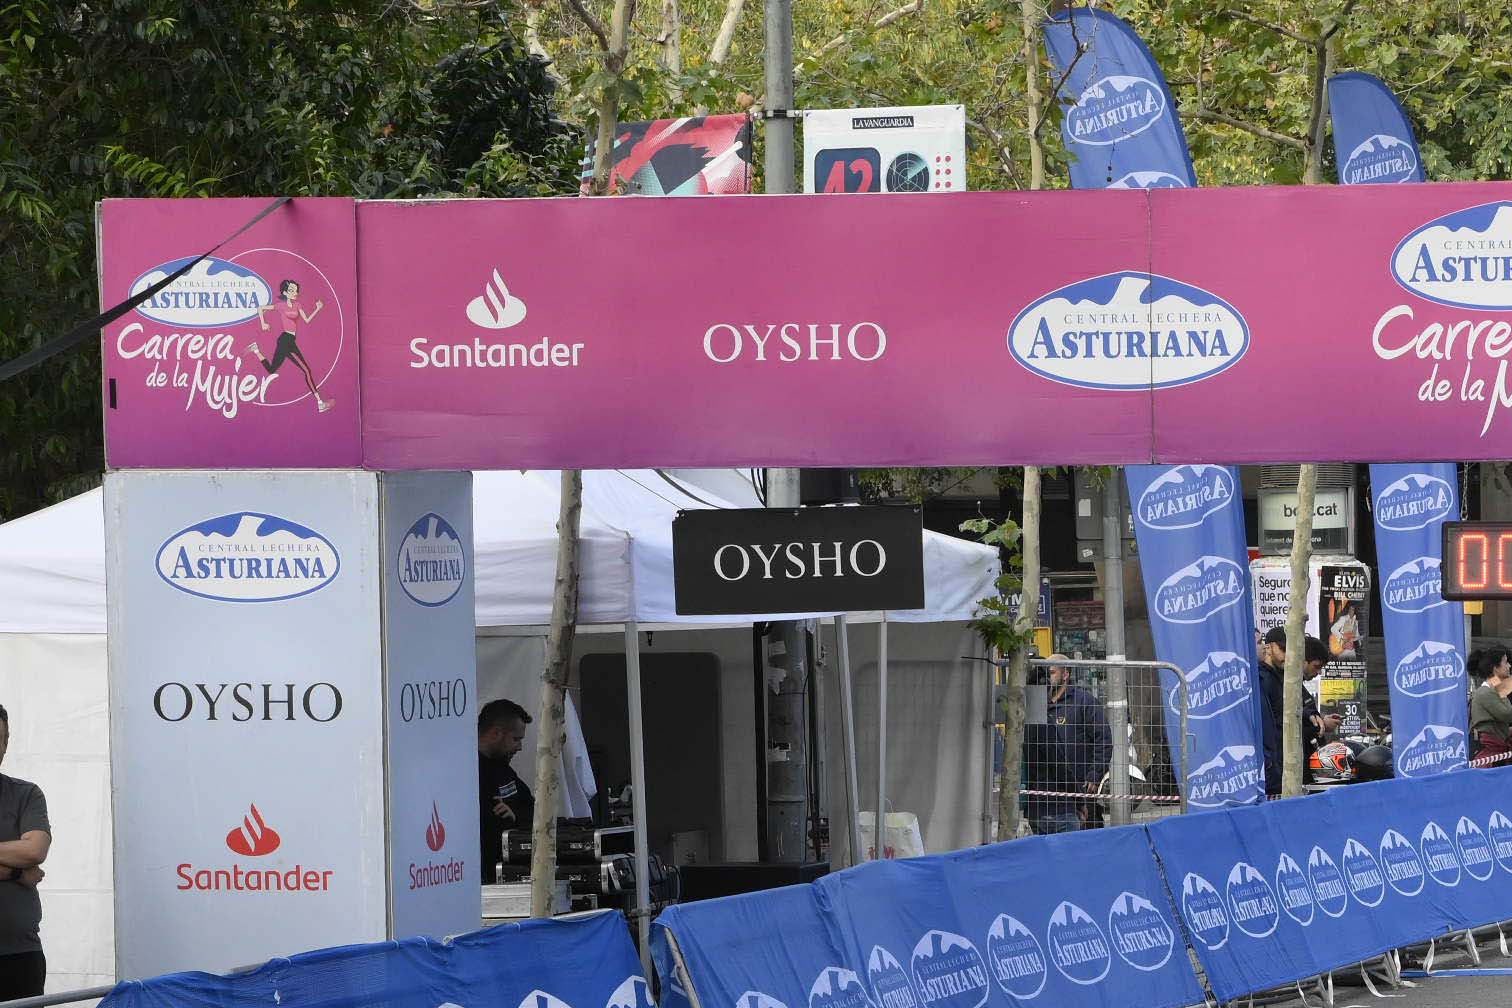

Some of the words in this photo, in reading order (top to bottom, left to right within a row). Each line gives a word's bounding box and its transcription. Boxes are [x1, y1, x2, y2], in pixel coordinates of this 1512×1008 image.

[854, 119, 864, 128] LA
[864, 117, 914, 128] VANGUARDIA
[162, 280, 206, 288] ENTRAL
[211, 279, 257, 288] LECHERA
[1064, 313, 1138, 325] CENTRAL
[1146, 312, 1222, 323] LECHERA
[117, 323, 234, 360] Carrera
[410, 337, 584, 368] Santander
[703, 321, 887, 363] OYSHO
[1027, 316, 1231, 359] ASTURIANA
[146, 362, 168, 387] de
[173, 363, 189, 388] la
[186, 357, 279, 419] Mujer
[1418, 363, 1453, 402] de
[1460, 363, 1485, 402] la
[171, 546, 327, 579] ASTURIANA
[199, 544, 256, 552] CENTRAL
[262, 544, 320, 552] LECHERA
[714, 539, 886, 581] OYSHO
[403, 548, 461, 582] ASTURIANA
[1334, 575, 1364, 587] ELVIS
[1260, 593, 1277, 603] que
[1261, 604, 1291, 615] quiere
[153, 682, 343, 722] OYSHO
[401, 678, 467, 723] OYSHO
[1345, 705, 1357, 715] 30
[176, 863, 333, 891] Santander
[409, 856, 464, 890] Santander
[993, 949, 1045, 981] ASTURIANA
[1054, 935, 1109, 967] ASTURIANA
[918, 965, 986, 1004] ASTURIANA
